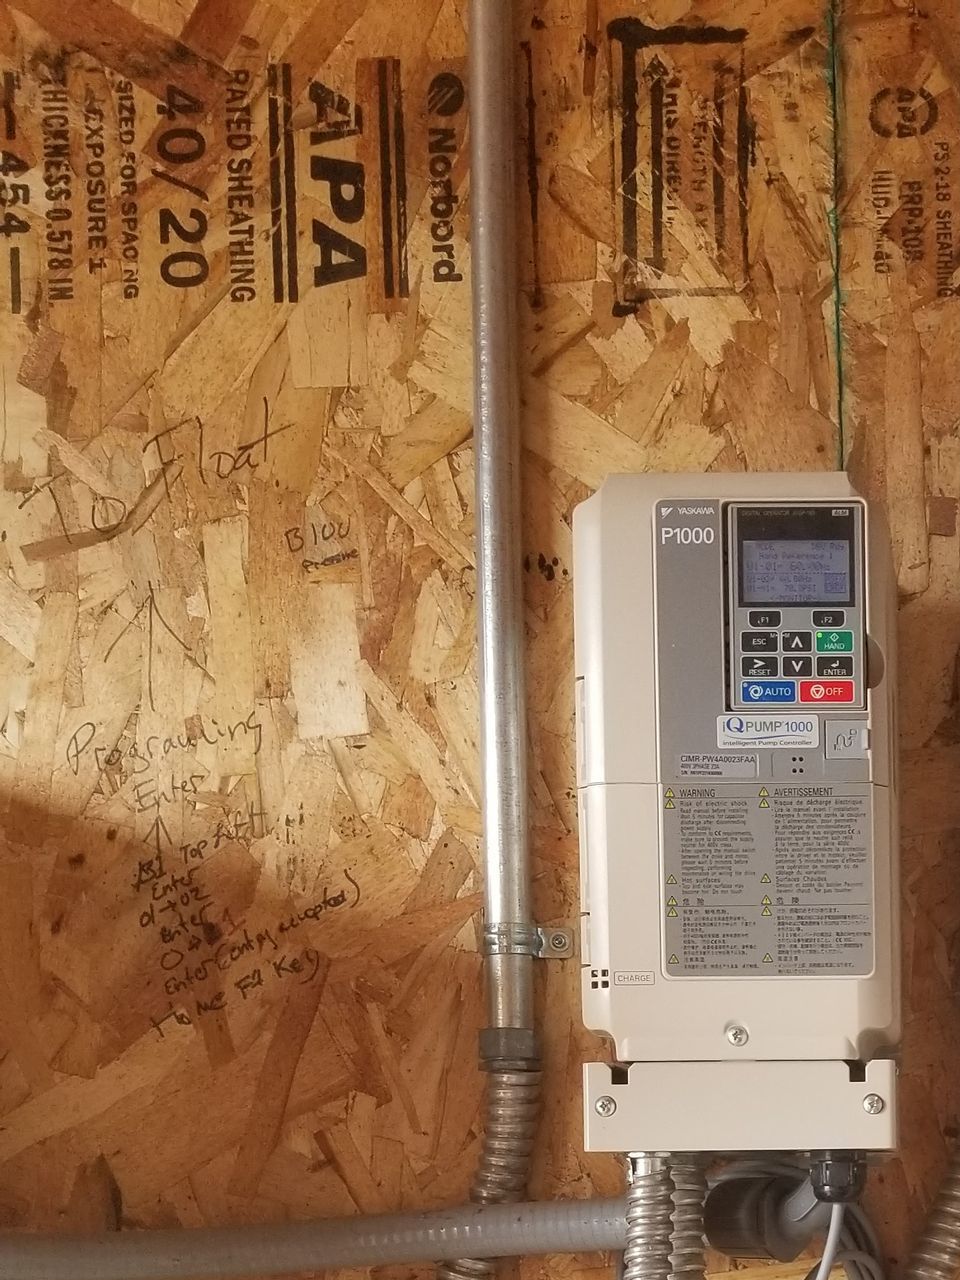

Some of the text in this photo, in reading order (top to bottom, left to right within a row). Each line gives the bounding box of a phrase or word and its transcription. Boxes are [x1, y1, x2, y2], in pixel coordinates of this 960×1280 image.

[117, 80, 136, 145] SIZED
[120, 151, 138, 198] FOR
[151, 84, 210, 288] 40/20
[226, 70, 257, 303] RATED SHEATHING
[309, 82, 367, 287] APA
[41, 83, 74, 308] HICKNESS 0.578 IN.
[429, 127, 463, 283] Norbord
[933, 140, 954, 298] PS 2-18 SHEATHING
[88, 257, 107, 275] 1
[677, 507, 715, 516] YASKAWA
[661, 527, 715, 545] P1000
[760, 616, 769, 624] F1
[824, 616, 833, 624] F2
[752, 638, 767, 646] ESC
[824, 642, 845, 650] HAND
[749, 668, 771, 676] RESET
[823, 668, 847, 676] ENTER
[764, 687, 791, 696] AUTO
[825, 687, 844, 695] OFF
[723, 739, 756, 747] Intelligent
[757, 739, 778, 747] Pump
[133, 773, 205, 814] Enter
[680, 788, 716, 798] WARNING
[774, 787, 833, 797] AVERTISSEMENT
[152, 866, 201, 901] Enter
[164, 958, 215, 996] Enter
[617, 974, 652, 982] CHARGE
